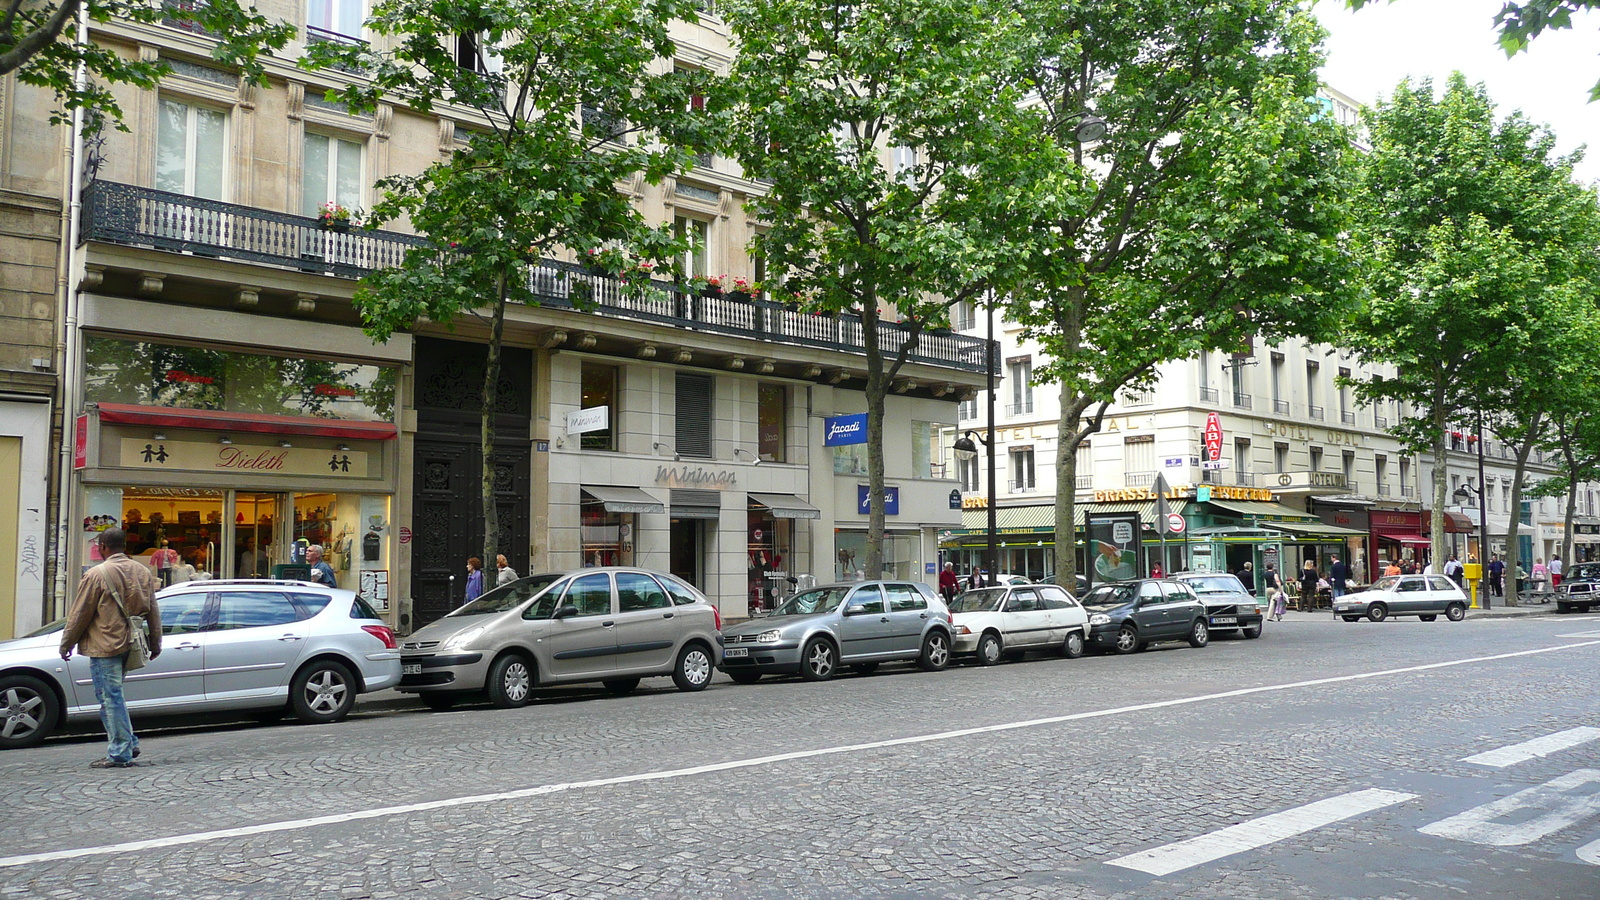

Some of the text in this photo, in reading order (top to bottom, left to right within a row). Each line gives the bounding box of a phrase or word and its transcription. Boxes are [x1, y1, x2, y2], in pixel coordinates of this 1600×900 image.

[1207, 416, 1219, 457] TABAC
[1327, 430, 1358, 446] OPAL
[540, 443, 546, 451] 17
[215, 446, 289, 471] Dieleth
